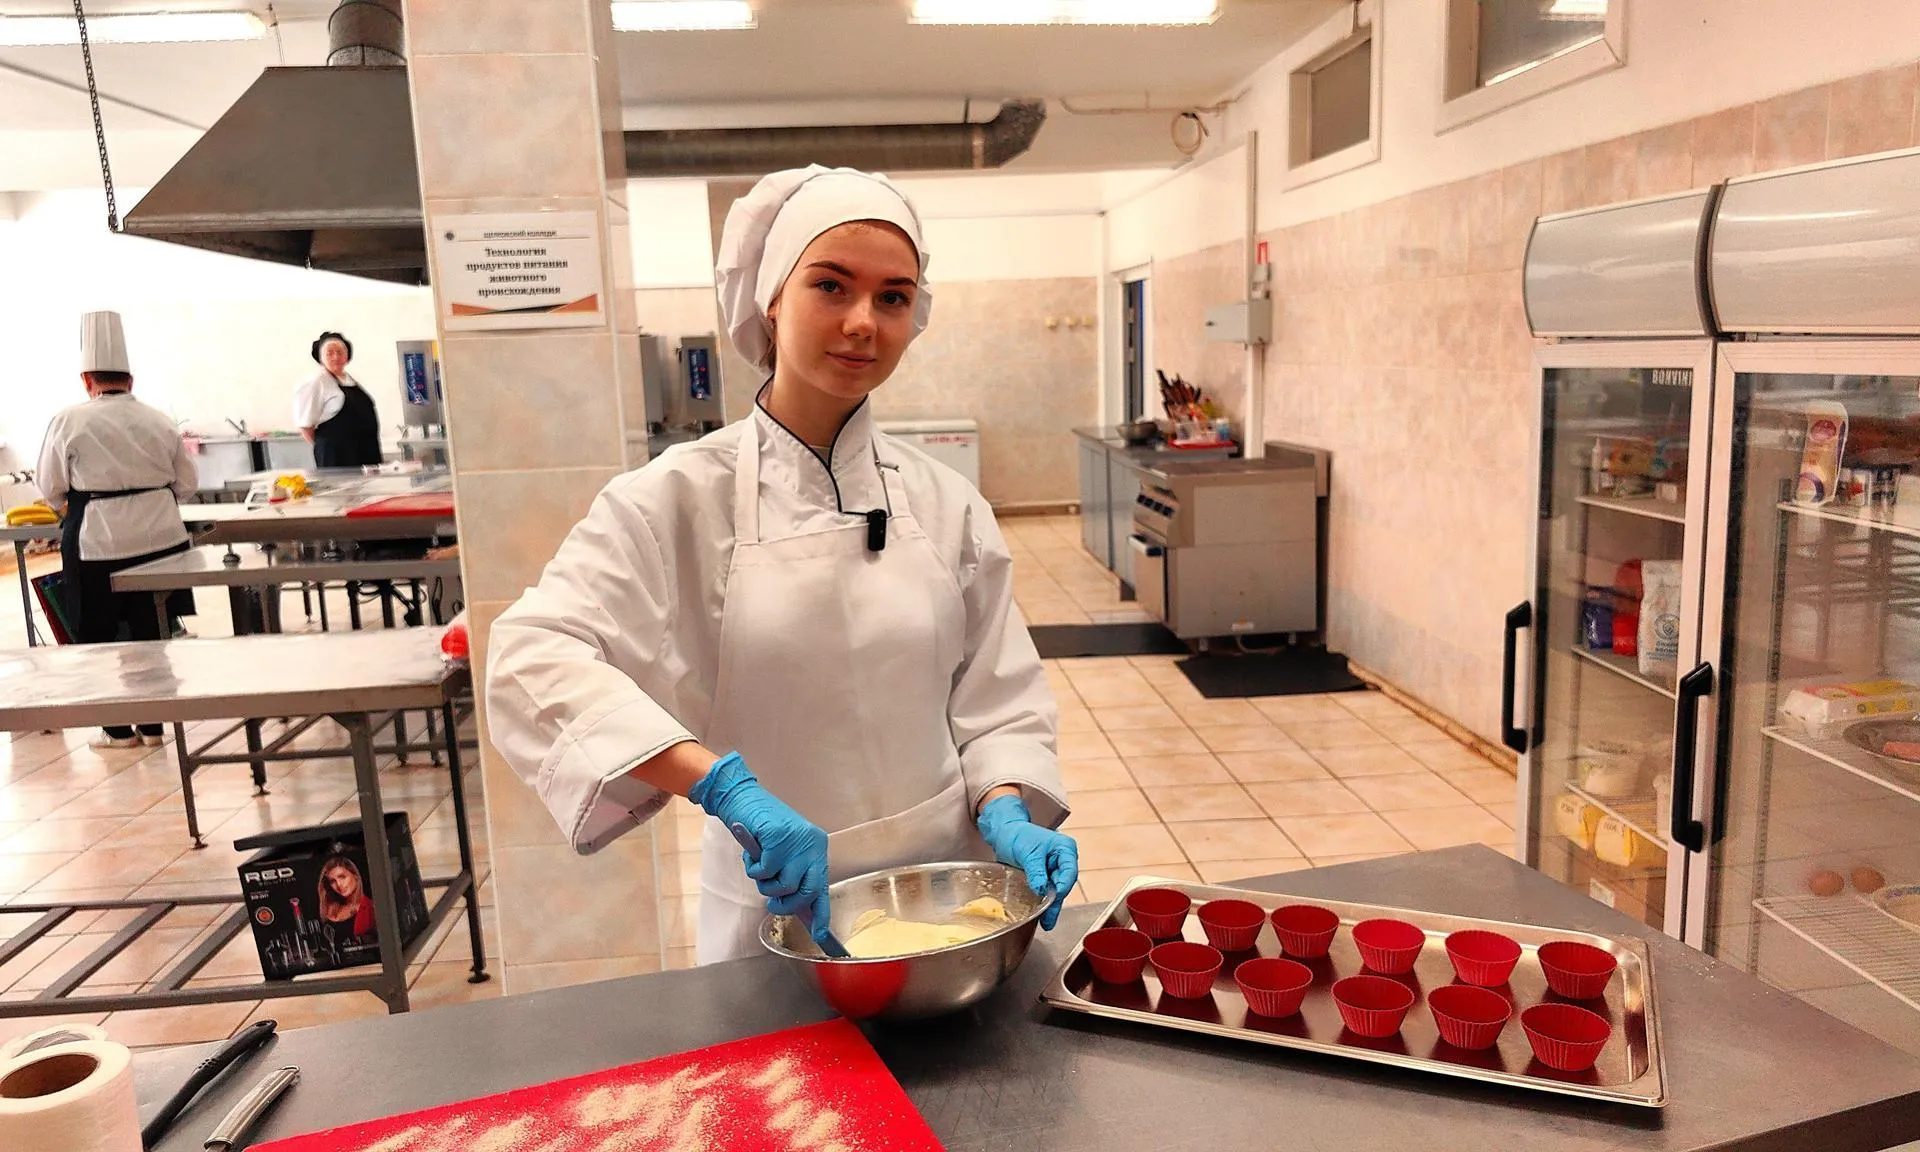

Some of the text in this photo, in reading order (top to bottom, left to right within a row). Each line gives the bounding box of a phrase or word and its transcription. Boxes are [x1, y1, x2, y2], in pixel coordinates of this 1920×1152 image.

[485, 247, 547, 257] Технология
[466, 260, 568, 272] продуктов питания
[489, 274, 547, 283] животного
[478, 286, 561, 298] происхождения
[245, 867, 294, 883] RED
